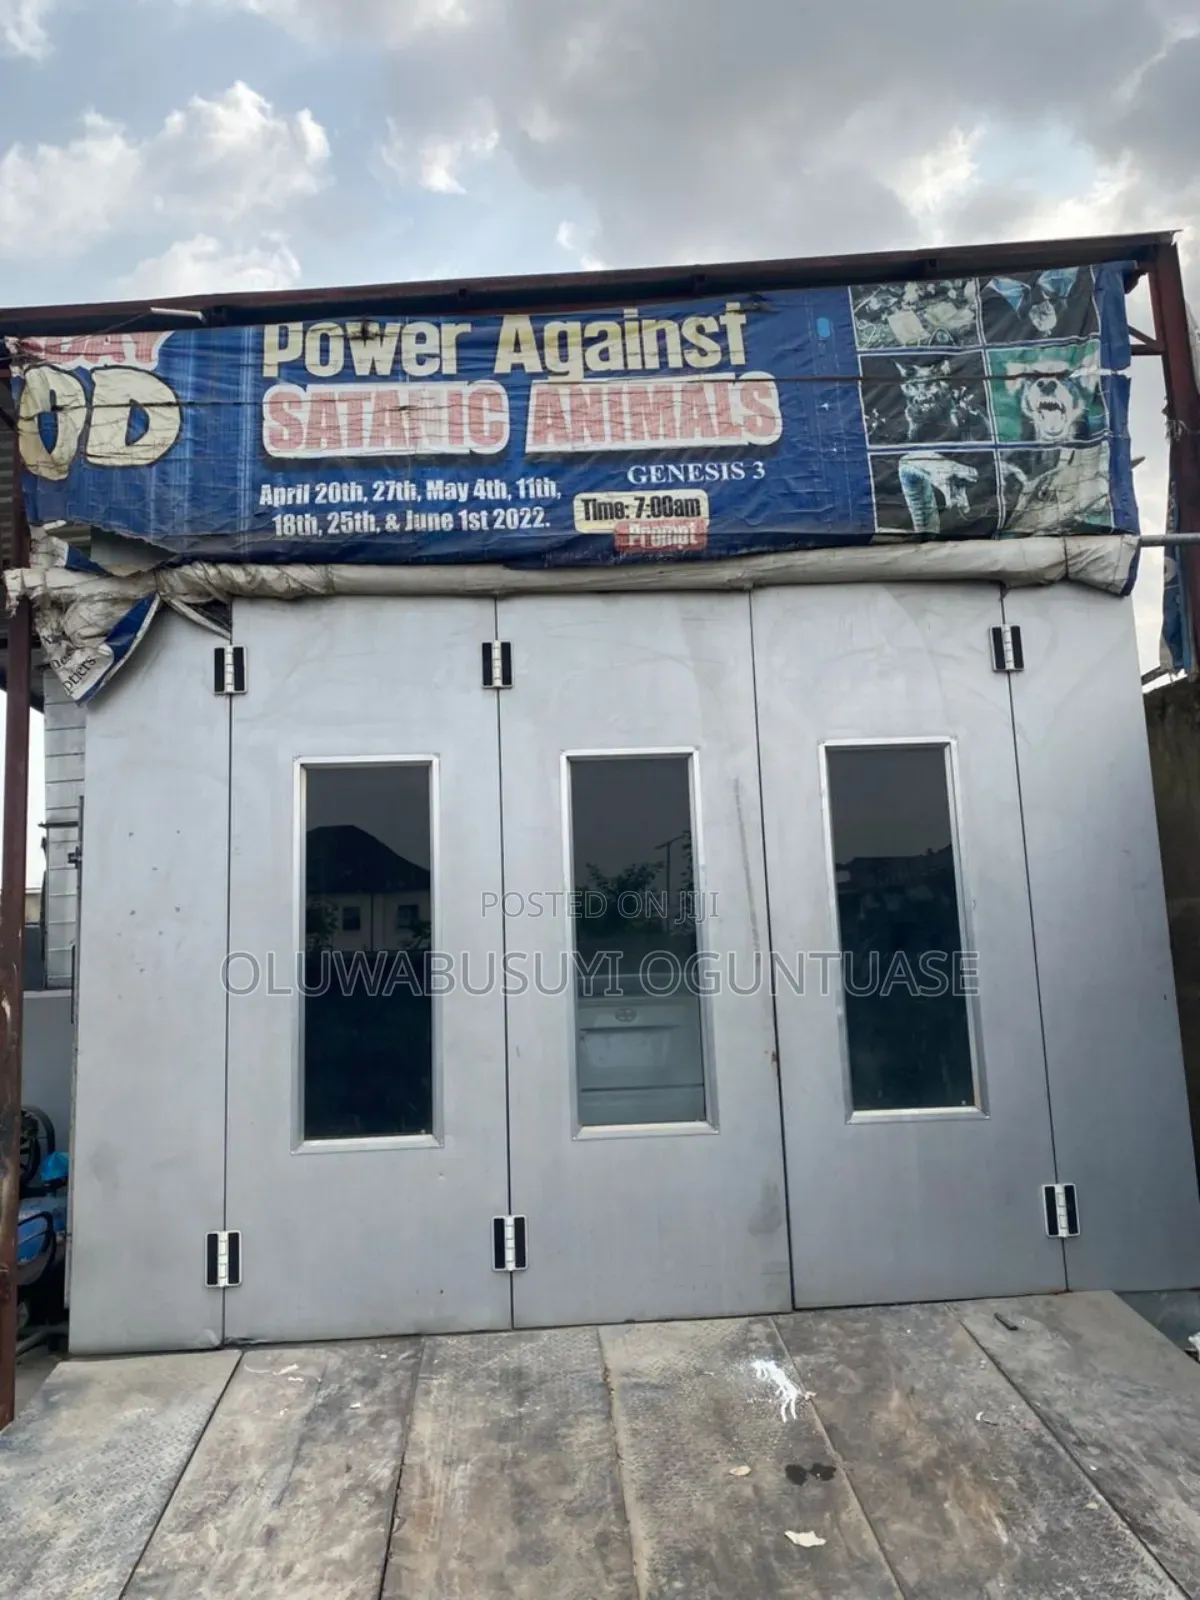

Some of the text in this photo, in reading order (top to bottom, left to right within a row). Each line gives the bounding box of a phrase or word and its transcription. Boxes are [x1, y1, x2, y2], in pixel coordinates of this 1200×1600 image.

[262, 302, 747, 381] Power Against
[264, 373, 781, 456] SATANIC ANIMALS
[627, 460, 766, 485] GENESIS 3
[259, 476, 562, 507] April 20th, 27th, May 4th, 11th,
[272, 506, 551, 537] 18th, 25th, & June 1st 2022.
[581, 495, 701, 521] Time: 7:00am
